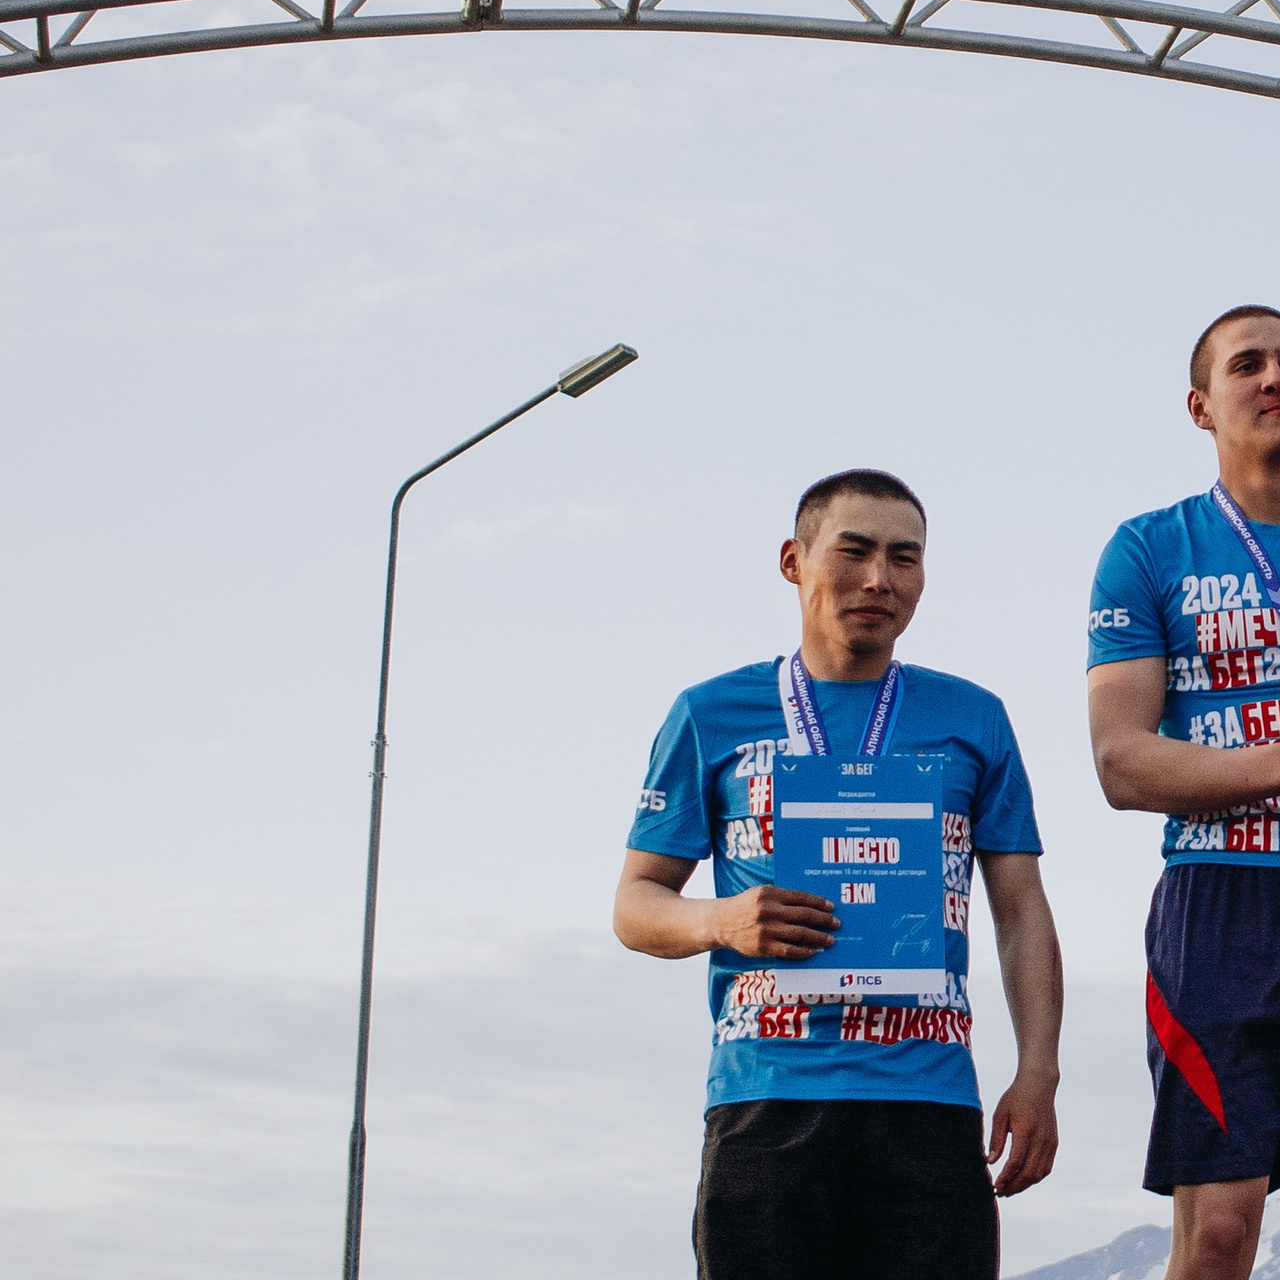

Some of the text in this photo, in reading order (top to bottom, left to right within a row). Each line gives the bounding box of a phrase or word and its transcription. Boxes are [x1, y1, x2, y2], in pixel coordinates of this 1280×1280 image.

[1212, 485, 1272, 581] САХАЛИНСКАЯ ОБЛАСТЬ
[1182, 572, 1262, 615] 2024
[792, 660, 816, 727] САХАЛИНСКАЯ
[838, 837, 901, 864] МЕСТО
[1175, 816, 1280, 852] #ЗАБЕГ
[841, 883, 876, 904] 5 КМ
[856, 975, 882, 985] ПСБ
